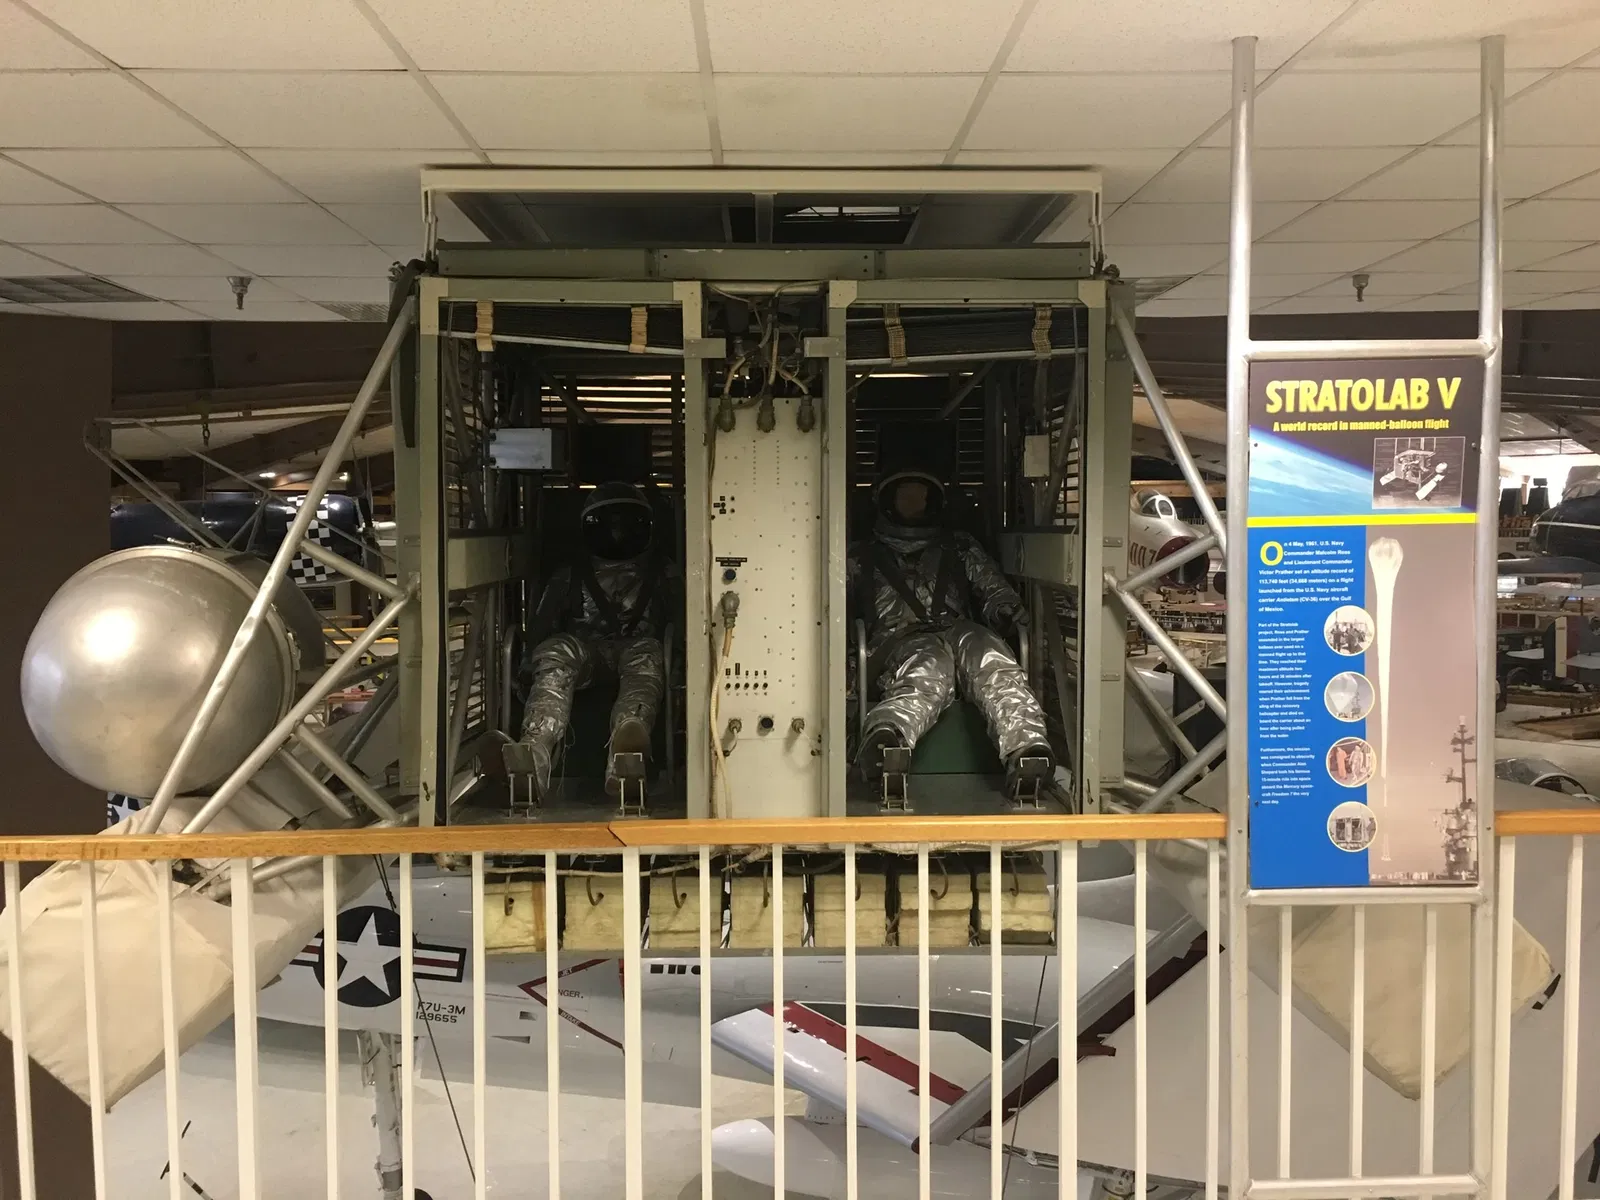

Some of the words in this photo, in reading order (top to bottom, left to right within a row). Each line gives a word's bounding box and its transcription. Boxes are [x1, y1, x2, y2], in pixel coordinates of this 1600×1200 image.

[1266, 378, 1430, 413] STRATOLAB
[1437, 378, 1462, 410] V
[1273, 422, 1280, 431] A
[1281, 422, 1306, 431] world
[1308, 421, 1338, 431] record
[1339, 421, 1349, 430] in
[1350, 419, 1423, 430] manned-balloon
[1425, 419, 1449, 430] flight
[558, 988, 584, 999] NGER.
[418, 1001, 466, 1014] F7U-3M
[416, 1011, 458, 1023] 129655
